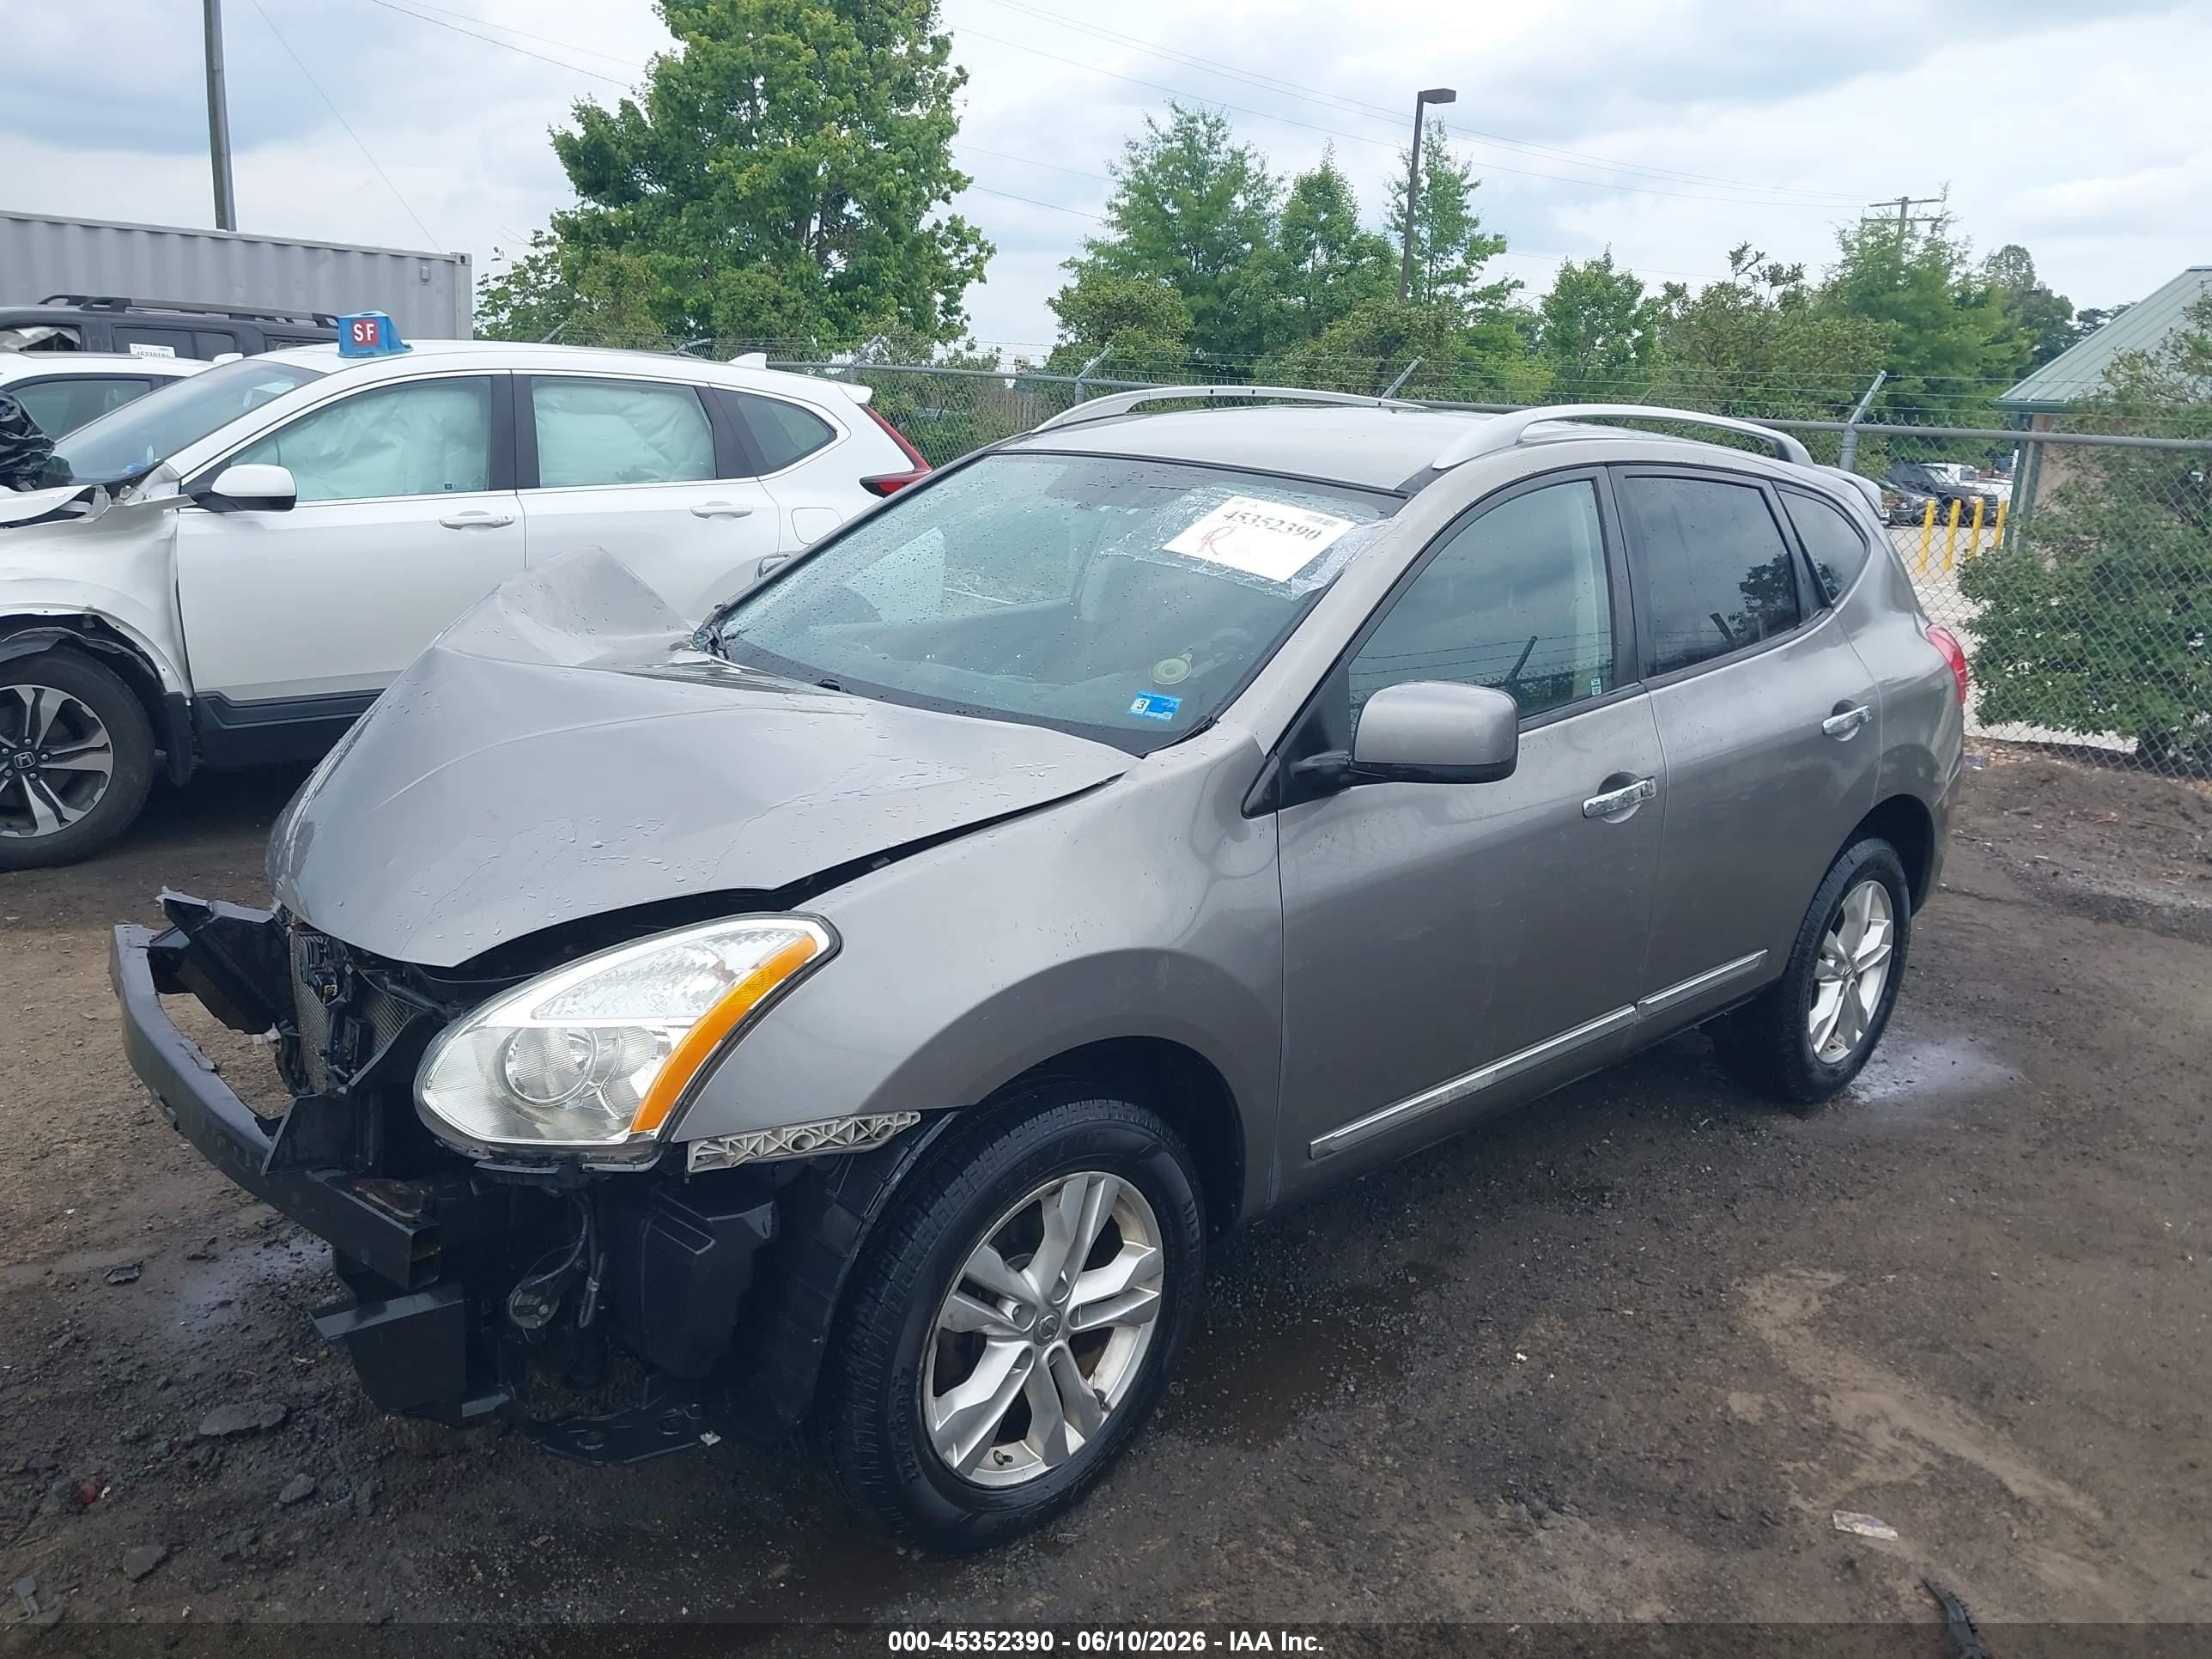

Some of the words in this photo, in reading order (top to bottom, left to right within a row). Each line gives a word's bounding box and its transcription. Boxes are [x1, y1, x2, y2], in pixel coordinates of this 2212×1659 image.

[353, 323, 375, 342] SF
[1223, 510, 1322, 540] 45352390
[1136, 699, 1147, 710] 3
